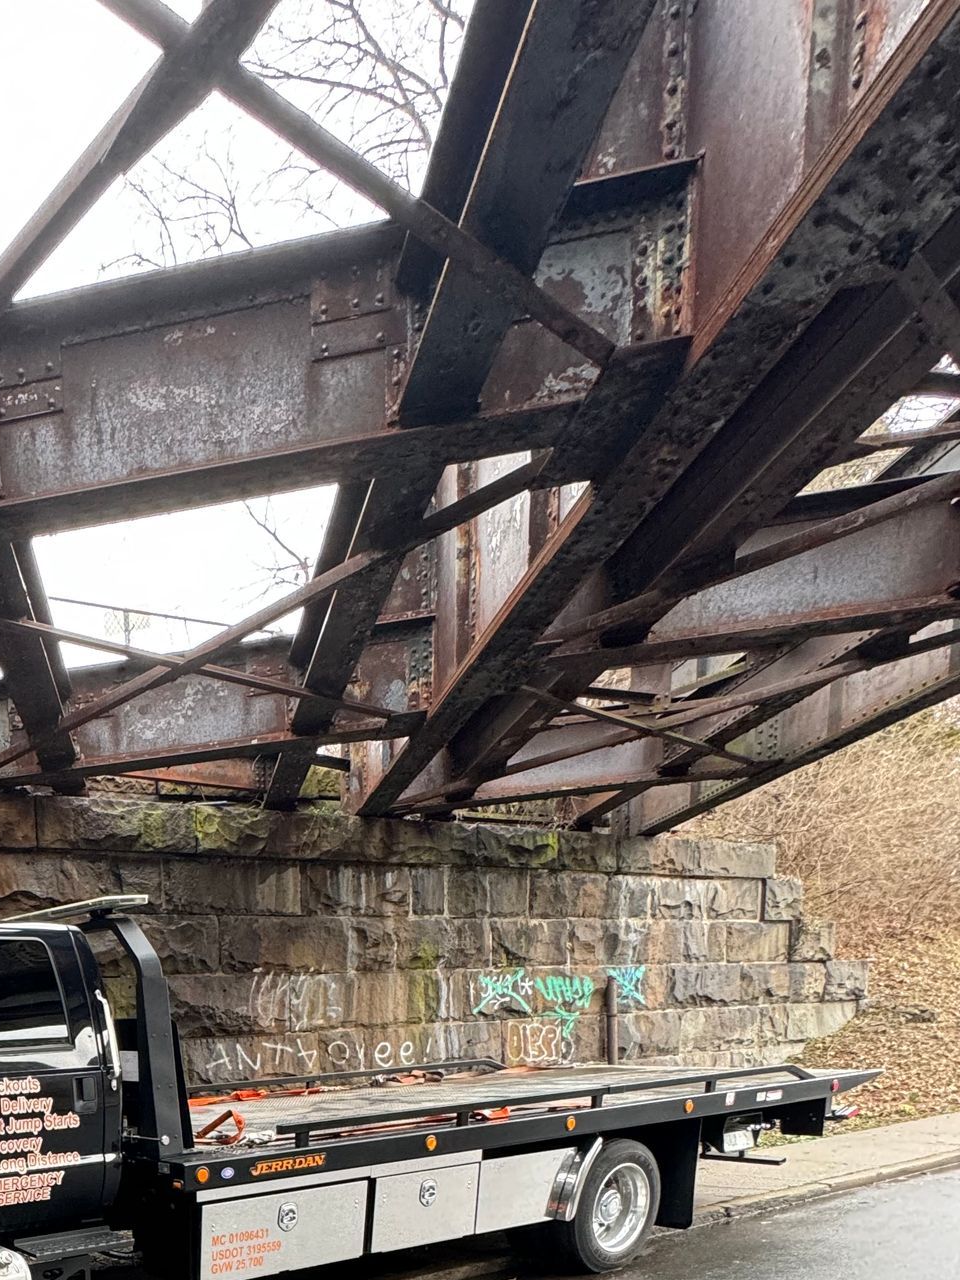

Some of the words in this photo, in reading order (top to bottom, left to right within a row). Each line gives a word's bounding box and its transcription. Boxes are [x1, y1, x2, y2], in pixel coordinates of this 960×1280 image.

[0, 1096, 53, 1116] Delivery
[6, 1117, 42, 1135] Jump
[43, 1111, 81, 1131] Starts
[26, 1151, 81, 1171] Distance
[211, 1234, 227, 1247] MC
[228, 1228, 270, 1244] 01096431
[211, 1246, 245, 1262] USDOT
[246, 1240, 282, 1256] 3195559
[211, 1260, 234, 1274] GVW
